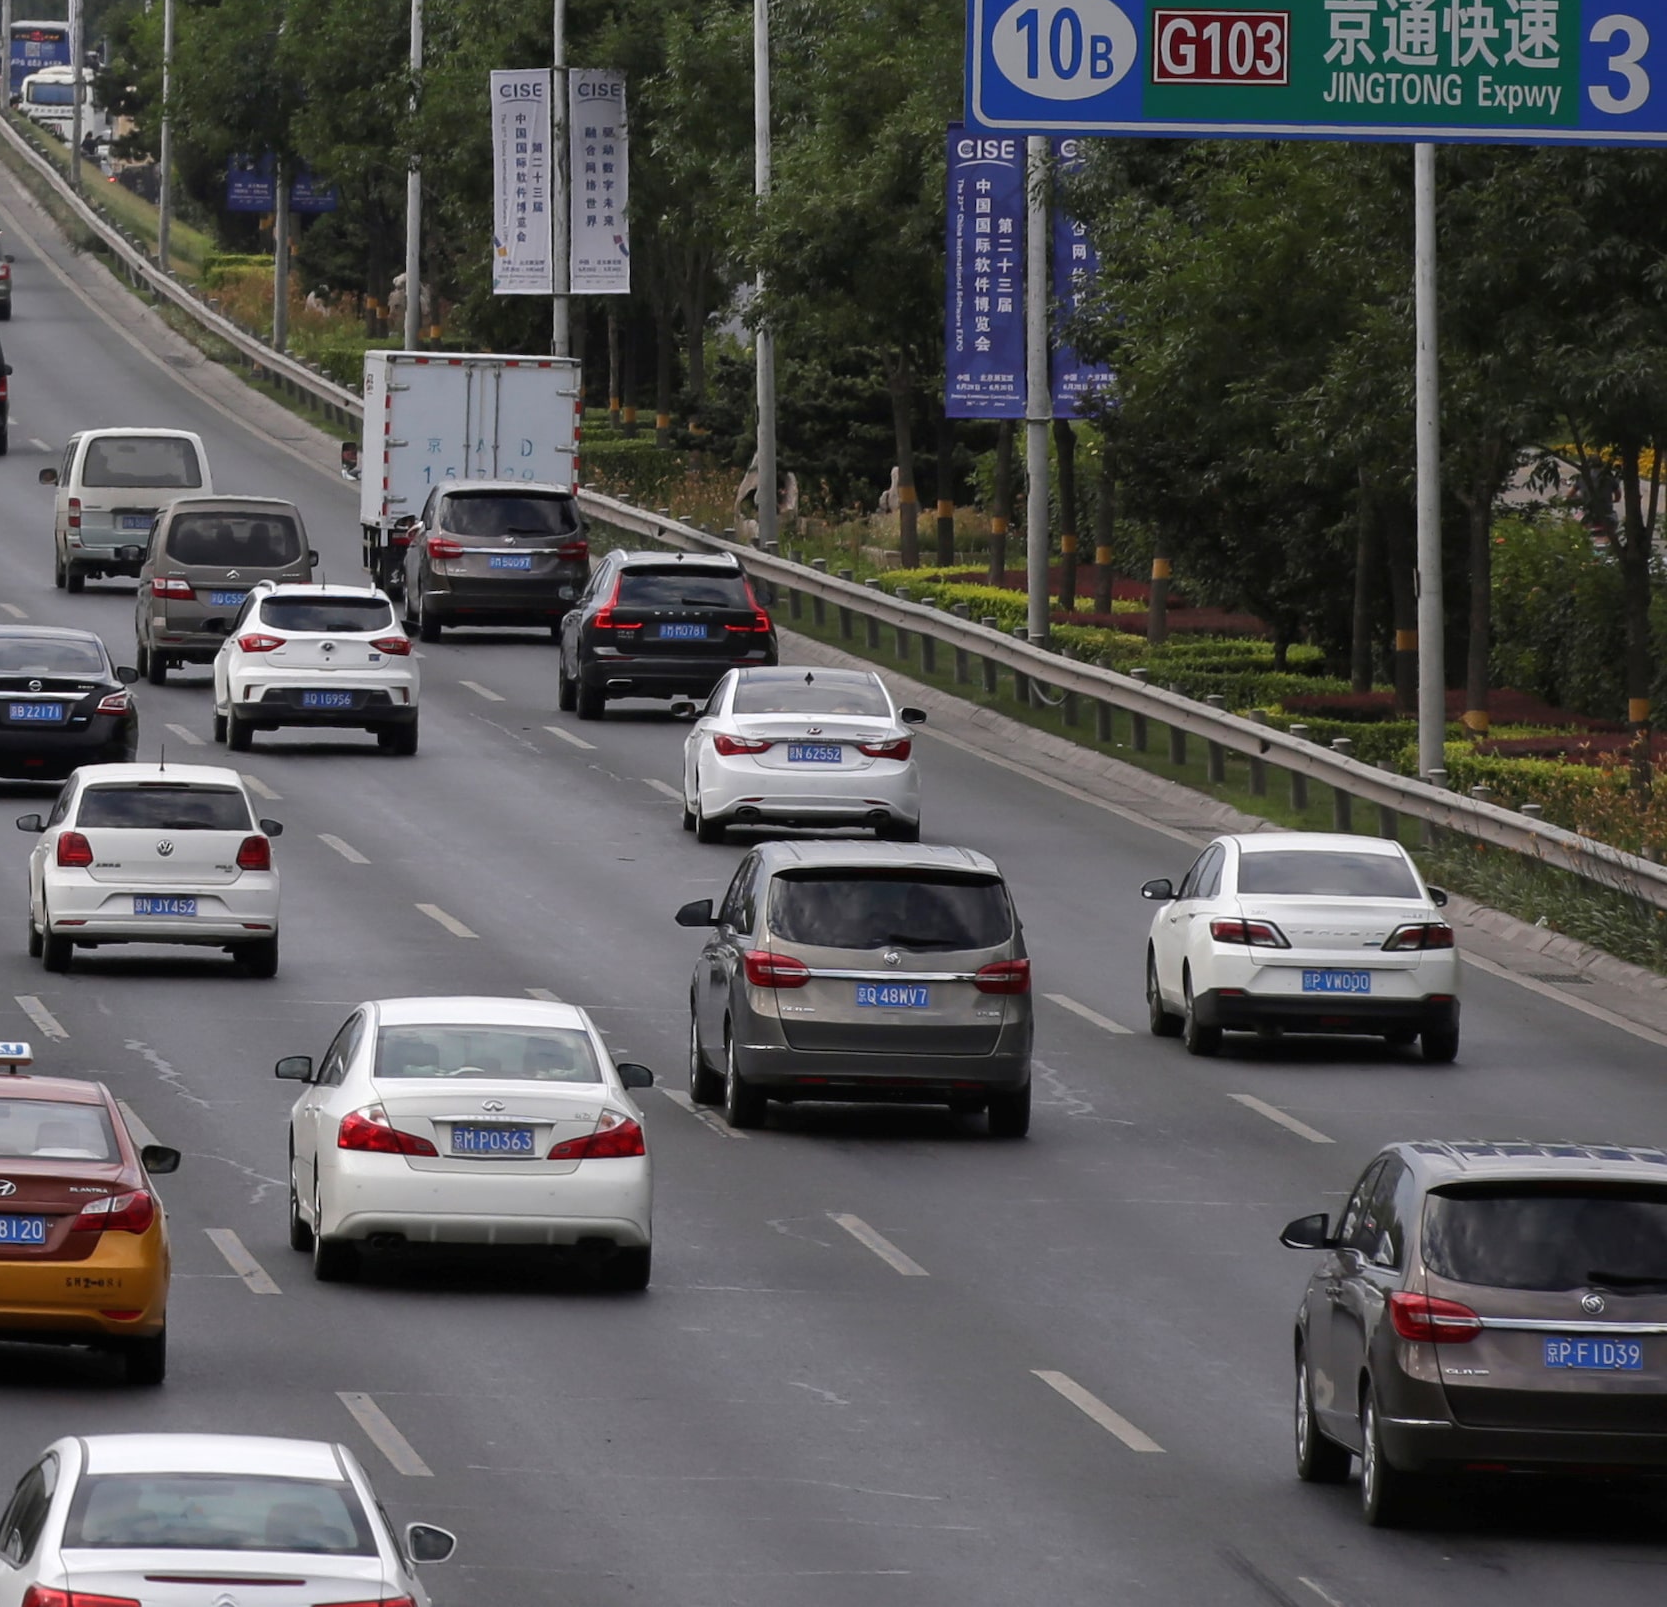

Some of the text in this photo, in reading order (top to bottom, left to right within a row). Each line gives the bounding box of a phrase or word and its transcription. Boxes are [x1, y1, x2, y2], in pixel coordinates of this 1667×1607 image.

[1014, 7, 1114, 81] 10B
[1160, 17, 1282, 77] G103
[1587, 14, 1651, 115] 3
[499, 82, 543, 98] CISE
[577, 82, 621, 98] CISE
[1323, 72, 1562, 115] JINGTONG Expwy
[957, 139, 1015, 159] CISE
[975, 178, 992, 352] 中国国际软件博览会
[996, 218, 1014, 313] 第二十三届
